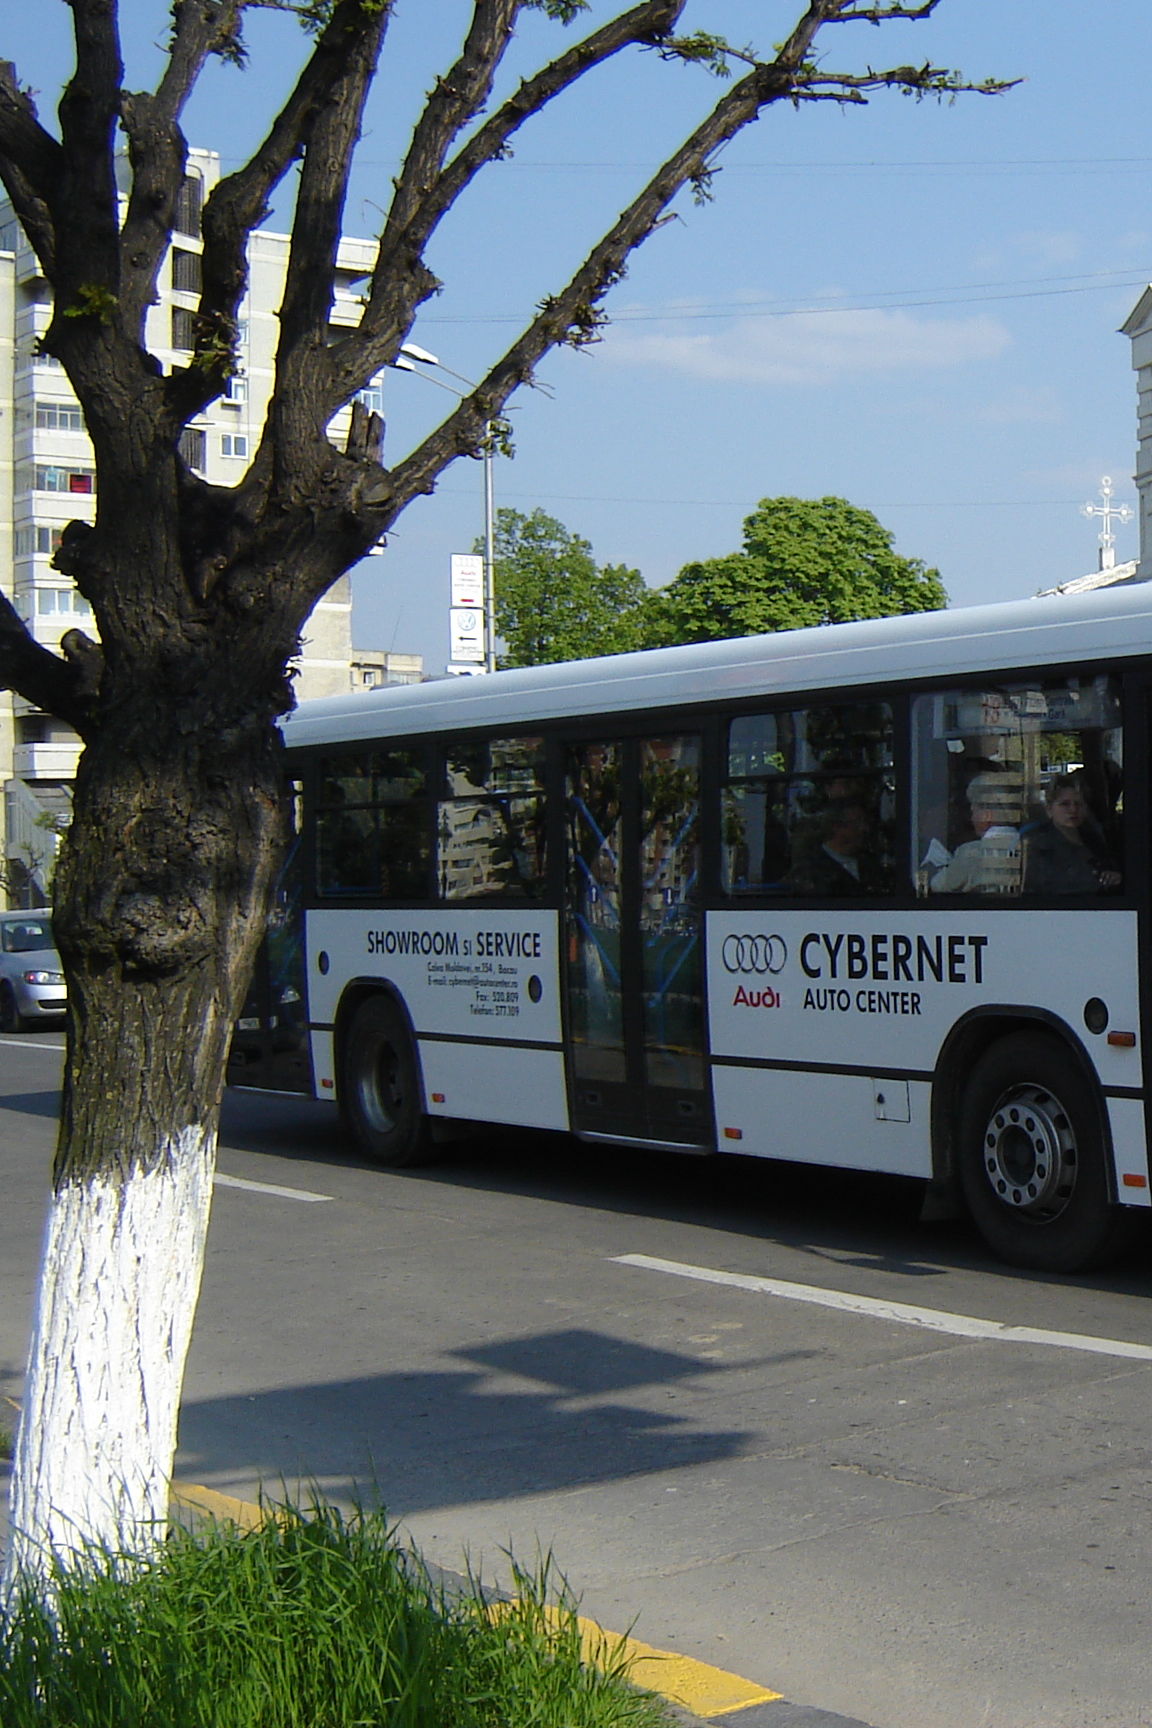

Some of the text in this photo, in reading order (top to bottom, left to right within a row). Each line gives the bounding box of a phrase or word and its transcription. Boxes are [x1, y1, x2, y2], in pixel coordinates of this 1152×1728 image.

[367, 930, 459, 956] SHOWROOM
[476, 931, 542, 958] SERVICE
[799, 932, 989, 984] CYBERNET
[733, 985, 781, 1008] Audi
[803, 988, 922, 1015] AUTO CENTER
